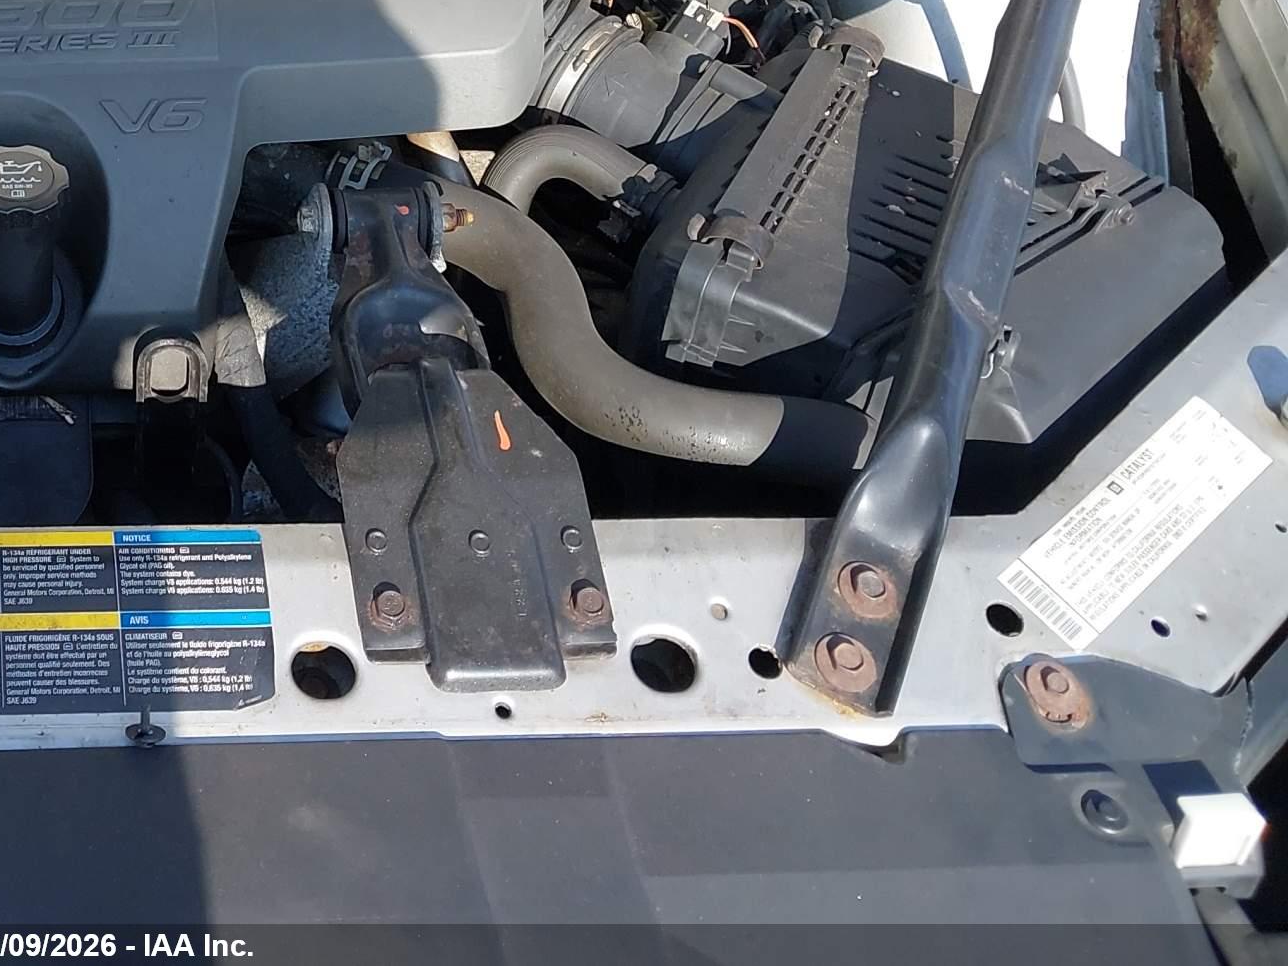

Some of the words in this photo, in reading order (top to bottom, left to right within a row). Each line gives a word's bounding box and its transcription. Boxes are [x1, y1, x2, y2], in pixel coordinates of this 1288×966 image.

[127, 30, 180, 50] III
[98, 97, 208, 134] V6
[70, 556, 92, 564] System
[168, 554, 201, 563] refrigerant
[214, 554, 252, 563] Polyalkylene
[39, 564, 47, 572] by
[48, 564, 74, 572] qualified
[119, 563, 138, 571] Glycol
[148, 562, 162, 570] (PAG
[132, 571, 155, 580] system
[182, 570, 196, 579] dye.
[37, 581, 64, 589] personal
[65, 580, 83, 588] injury.
[120, 580, 144, 588] System
[144, 579, 166, 588] charge
[175, 578, 214, 588] applications:
[233, 578, 242, 586] kg
[242, 577, 255, 585] (1.2
[121, 588, 145, 596] System
[145, 588, 167, 597] charge
[176, 587, 215, 596] applications:
[234, 586, 243, 594] kg
[243, 585, 256, 594] (1.4
[129, 616, 149, 624] AVIS
[28, 634, 71, 642] FRIGORIGÈNE
[208, 640, 242, 650] frigorigène
[145, 660, 161, 668] PAG).
[136, 668, 163, 677] système
[128, 677, 151, 686] Charge
[161, 676, 189, 685] système,
[221, 676, 230, 684] kg
[53, 687, 89, 695] Corporation,
[128, 686, 152, 695] Charge
[222, 684, 231, 693] kg
